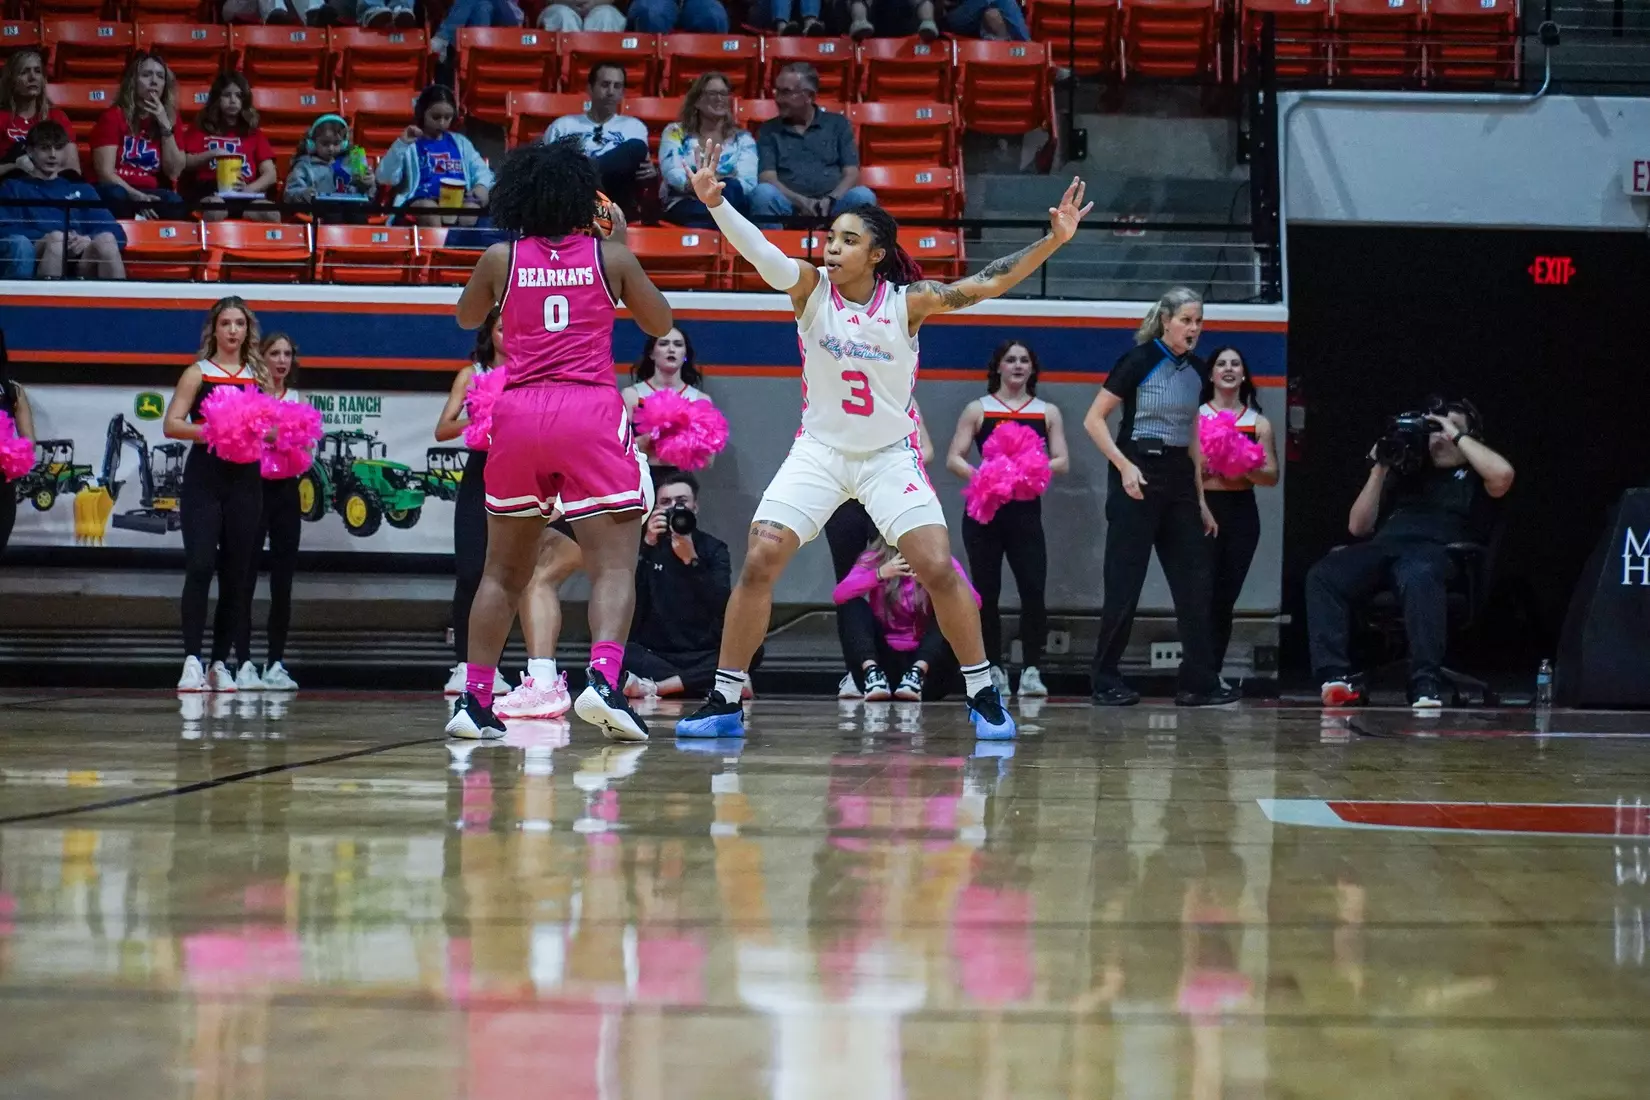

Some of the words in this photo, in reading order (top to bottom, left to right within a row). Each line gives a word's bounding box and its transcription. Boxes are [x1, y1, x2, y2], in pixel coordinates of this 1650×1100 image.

[1632, 160, 1650, 192] E
[517, 267, 594, 287] BEARKATS
[1534, 256, 1572, 284] EXIT
[543, 294, 569, 332] 0
[339, 396, 382, 412] RANCH
[841, 370, 874, 417] 3
[343, 414, 363, 424] TURF
[1621, 554, 1650, 585] H
